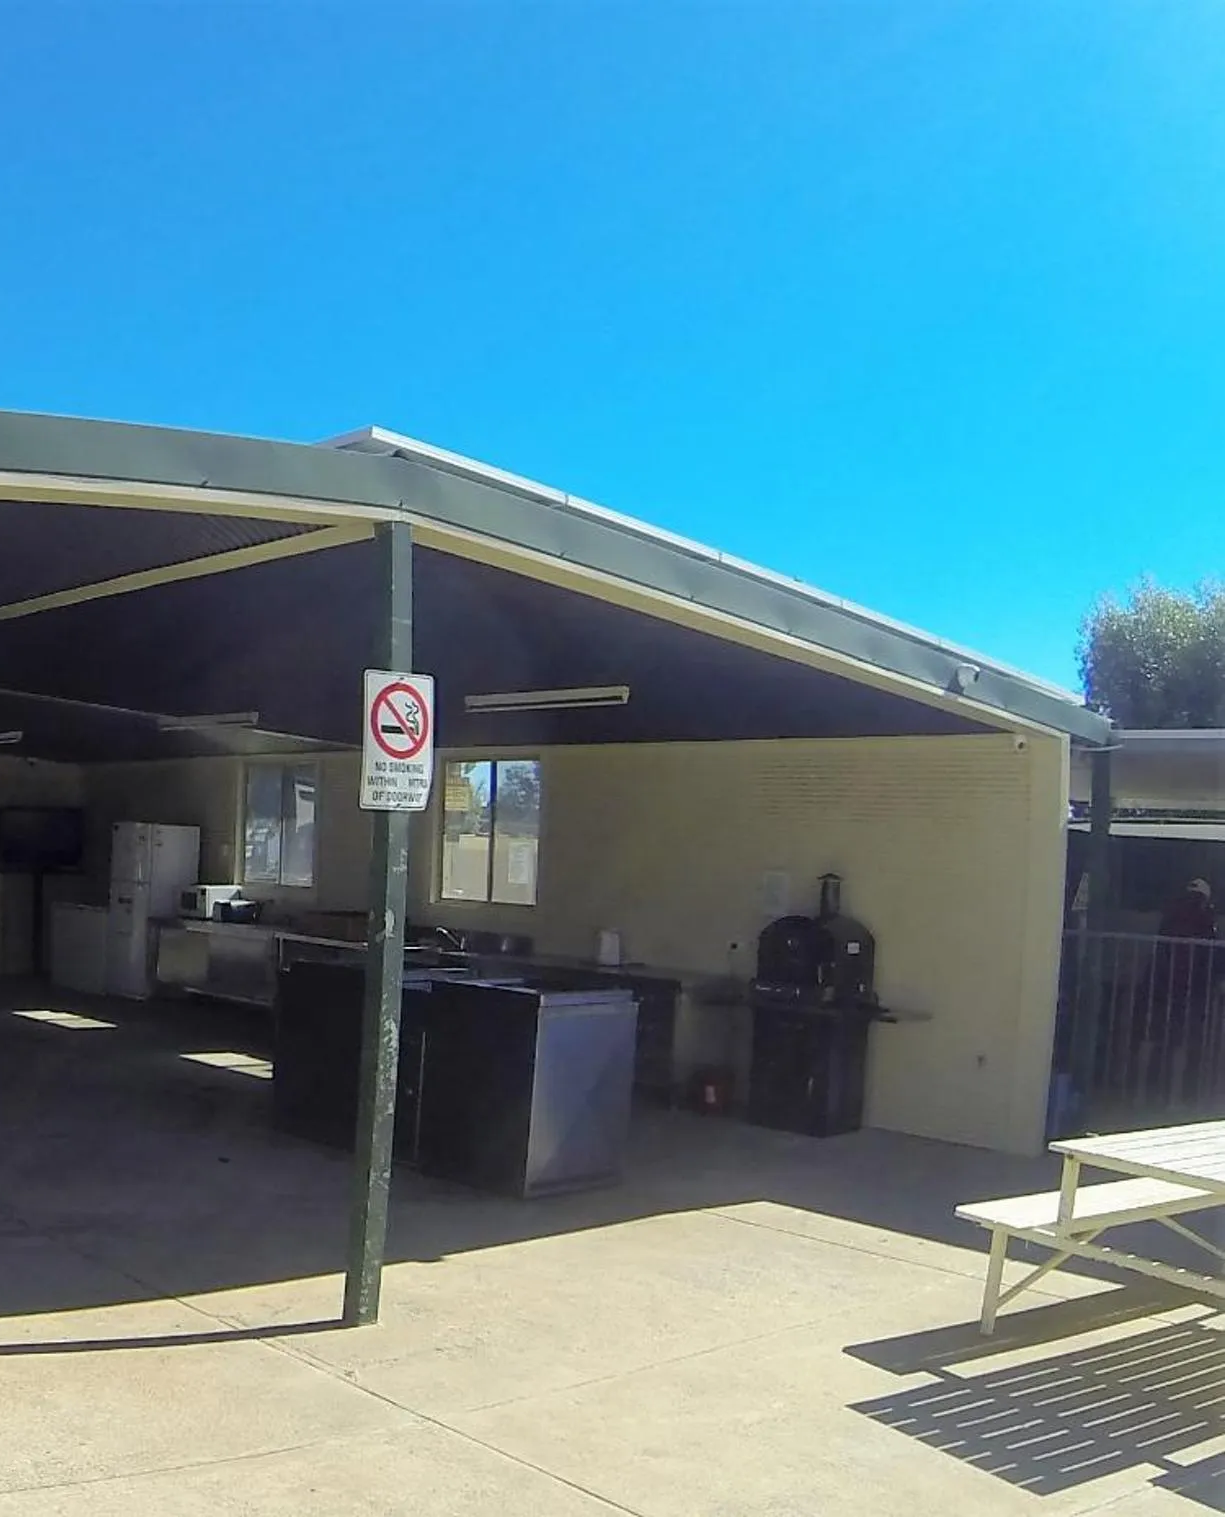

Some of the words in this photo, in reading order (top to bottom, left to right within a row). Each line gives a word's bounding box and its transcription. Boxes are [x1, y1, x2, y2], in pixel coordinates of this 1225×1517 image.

[375, 761, 387, 773] NO
[389, 762, 424, 775] SMOKING
[367, 775, 398, 787] WITHIN
[372, 790, 385, 801] OF
